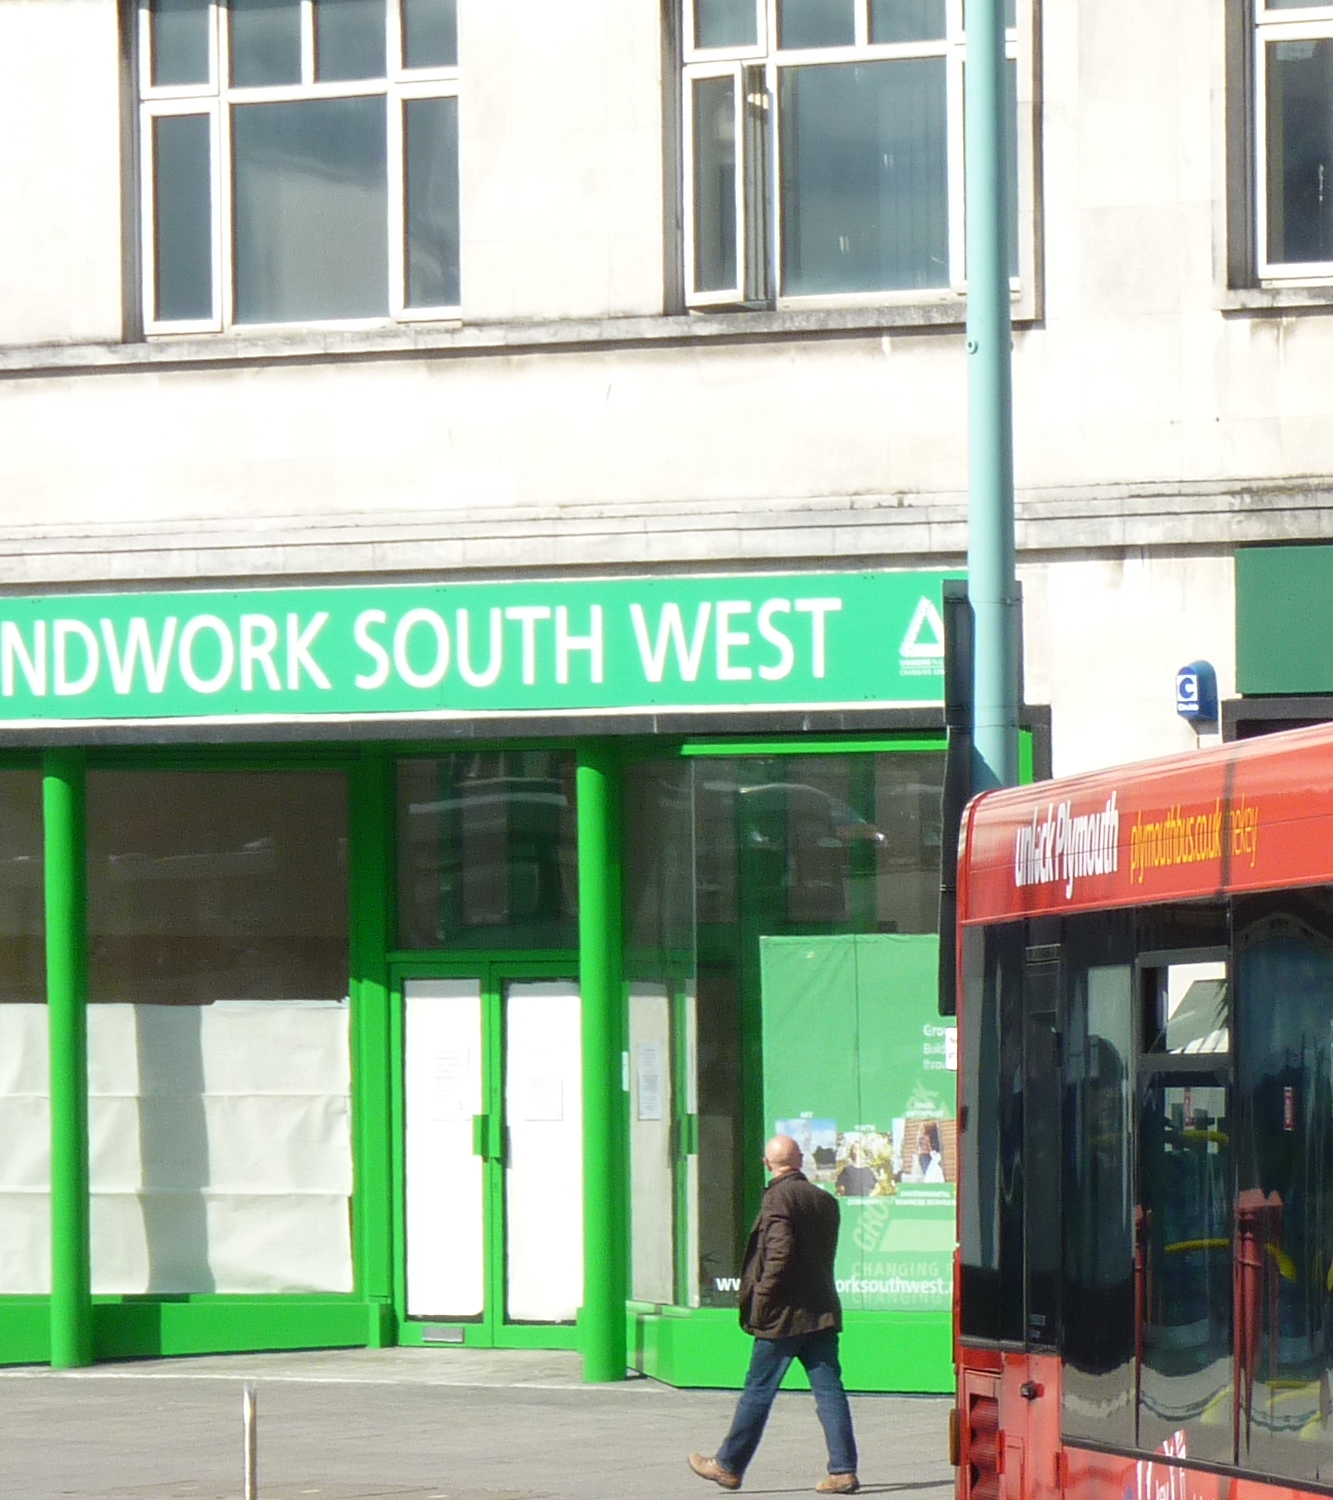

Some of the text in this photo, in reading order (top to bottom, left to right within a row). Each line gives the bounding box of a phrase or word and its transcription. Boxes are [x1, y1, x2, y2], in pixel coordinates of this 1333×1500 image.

[0, 597, 843, 698] NDWORK SOUTH WEST
[1056, 791, 1119, 900] Plymouth
